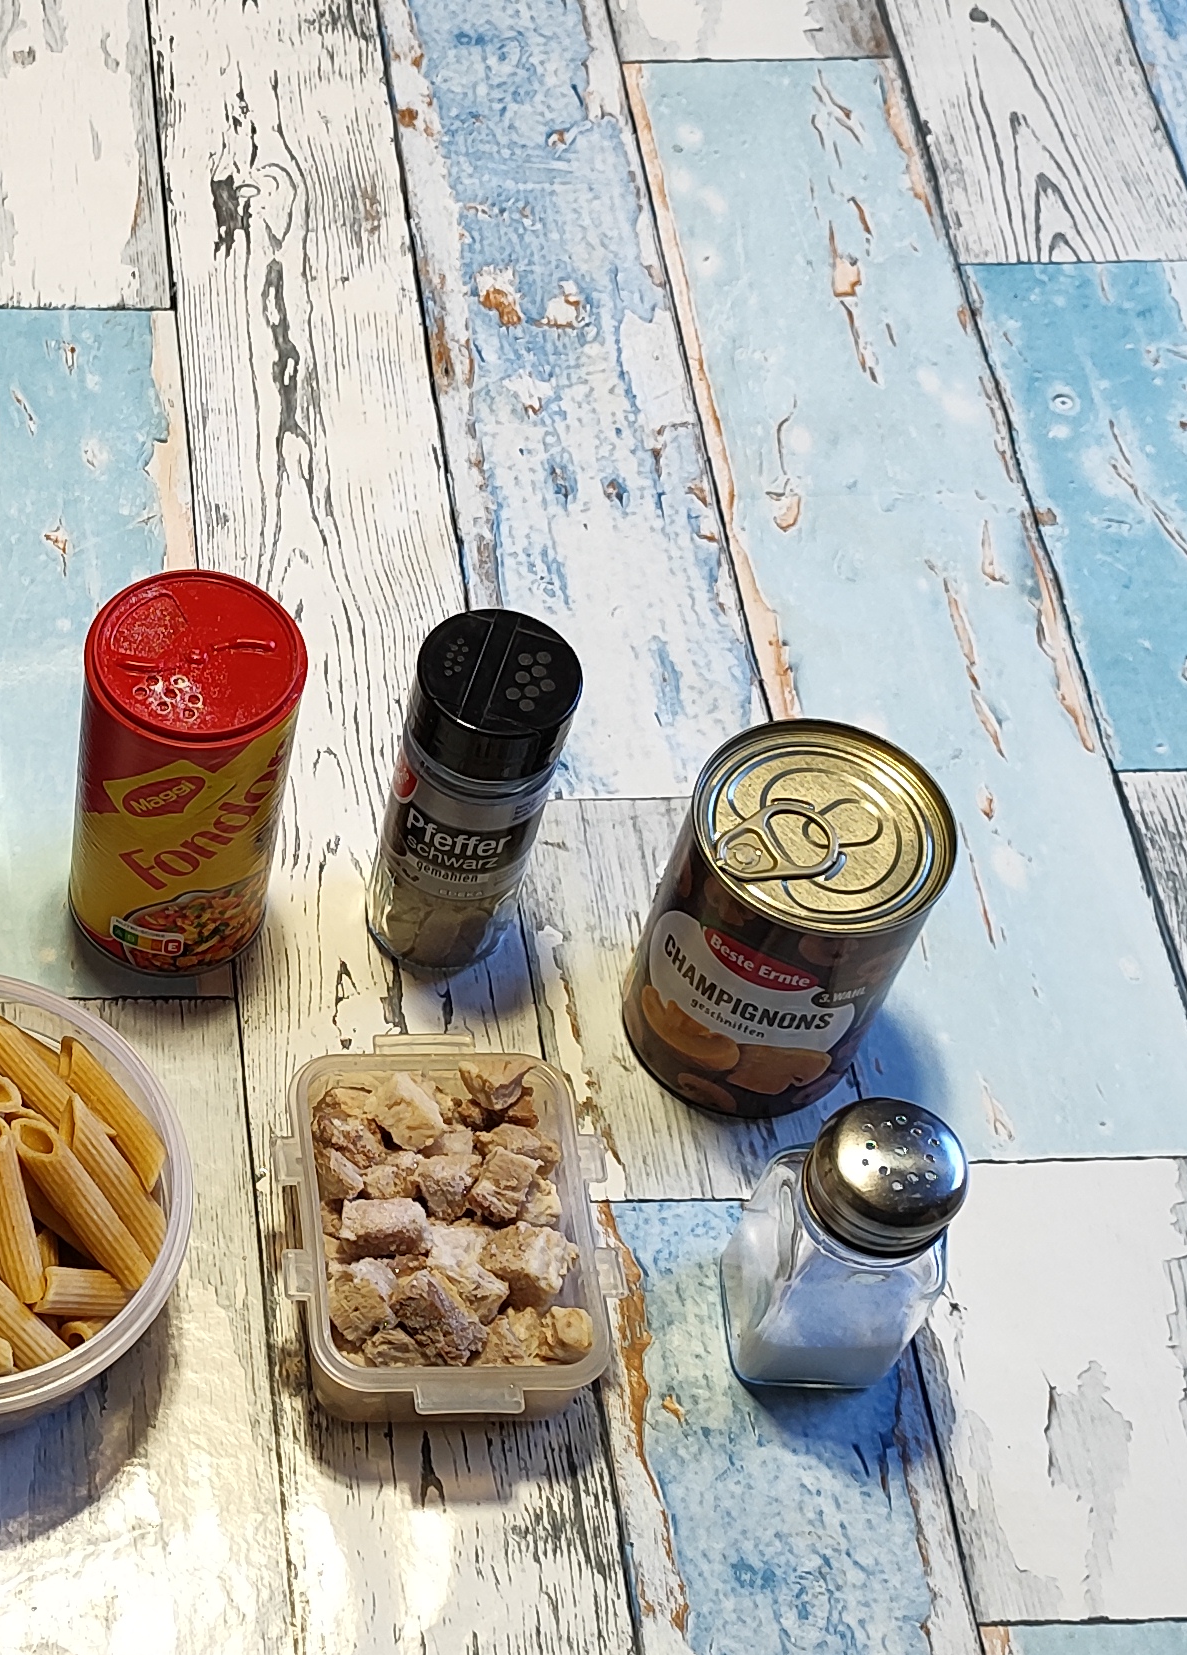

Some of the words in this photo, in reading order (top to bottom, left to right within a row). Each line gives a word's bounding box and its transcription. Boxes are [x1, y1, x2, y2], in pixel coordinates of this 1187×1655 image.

[129, 780, 197, 815] Maggi
[406, 807, 512, 856] Pfeffer
[407, 834, 499, 870] schwarz
[416, 858, 479, 884] gemahlen
[439, 888, 484, 898] EDEKA
[710, 936, 754, 972] Beste
[757, 964, 811, 988] Ernte
[664, 933, 835, 1032] CHAMPIGNONS
[832, 986, 866, 1002] WAHL
[690, 997, 765, 1039] geschnitten
